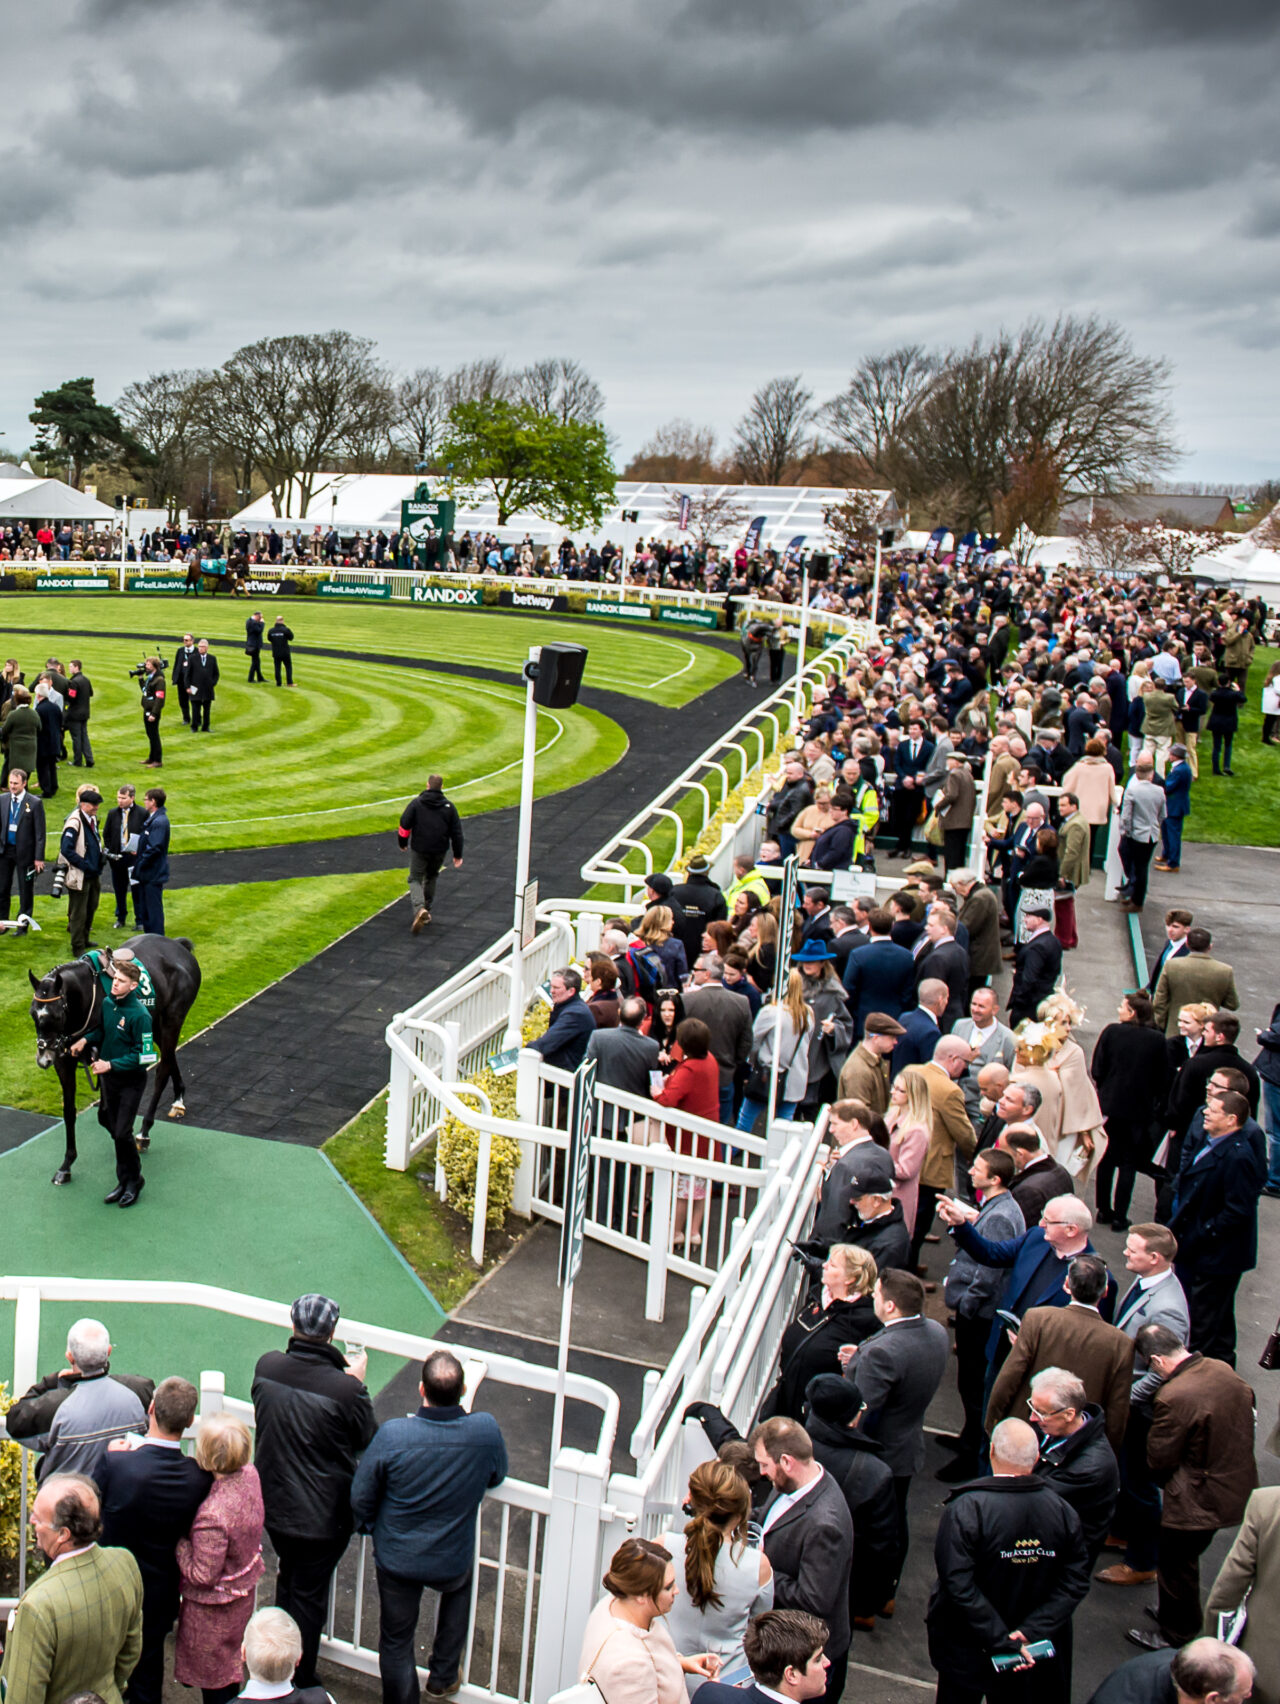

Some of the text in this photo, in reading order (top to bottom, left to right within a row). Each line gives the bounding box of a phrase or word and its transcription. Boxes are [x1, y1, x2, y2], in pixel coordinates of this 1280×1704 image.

[37, 579, 72, 588] RANDOX
[237, 580, 281, 594] etway
[322, 585, 385, 596] #FeelLikeAWinner
[414, 587, 478, 604] RANDOX
[512, 592, 554, 610] betway
[586, 602, 619, 613] RANDOX
[782, 864, 799, 998] RANDOX
[139, 972, 152, 996] 3
[145, 1043, 151, 1051] 3
[569, 1067, 596, 1283] RANDOX
[1036, 1547, 1056, 1557] CLUB
